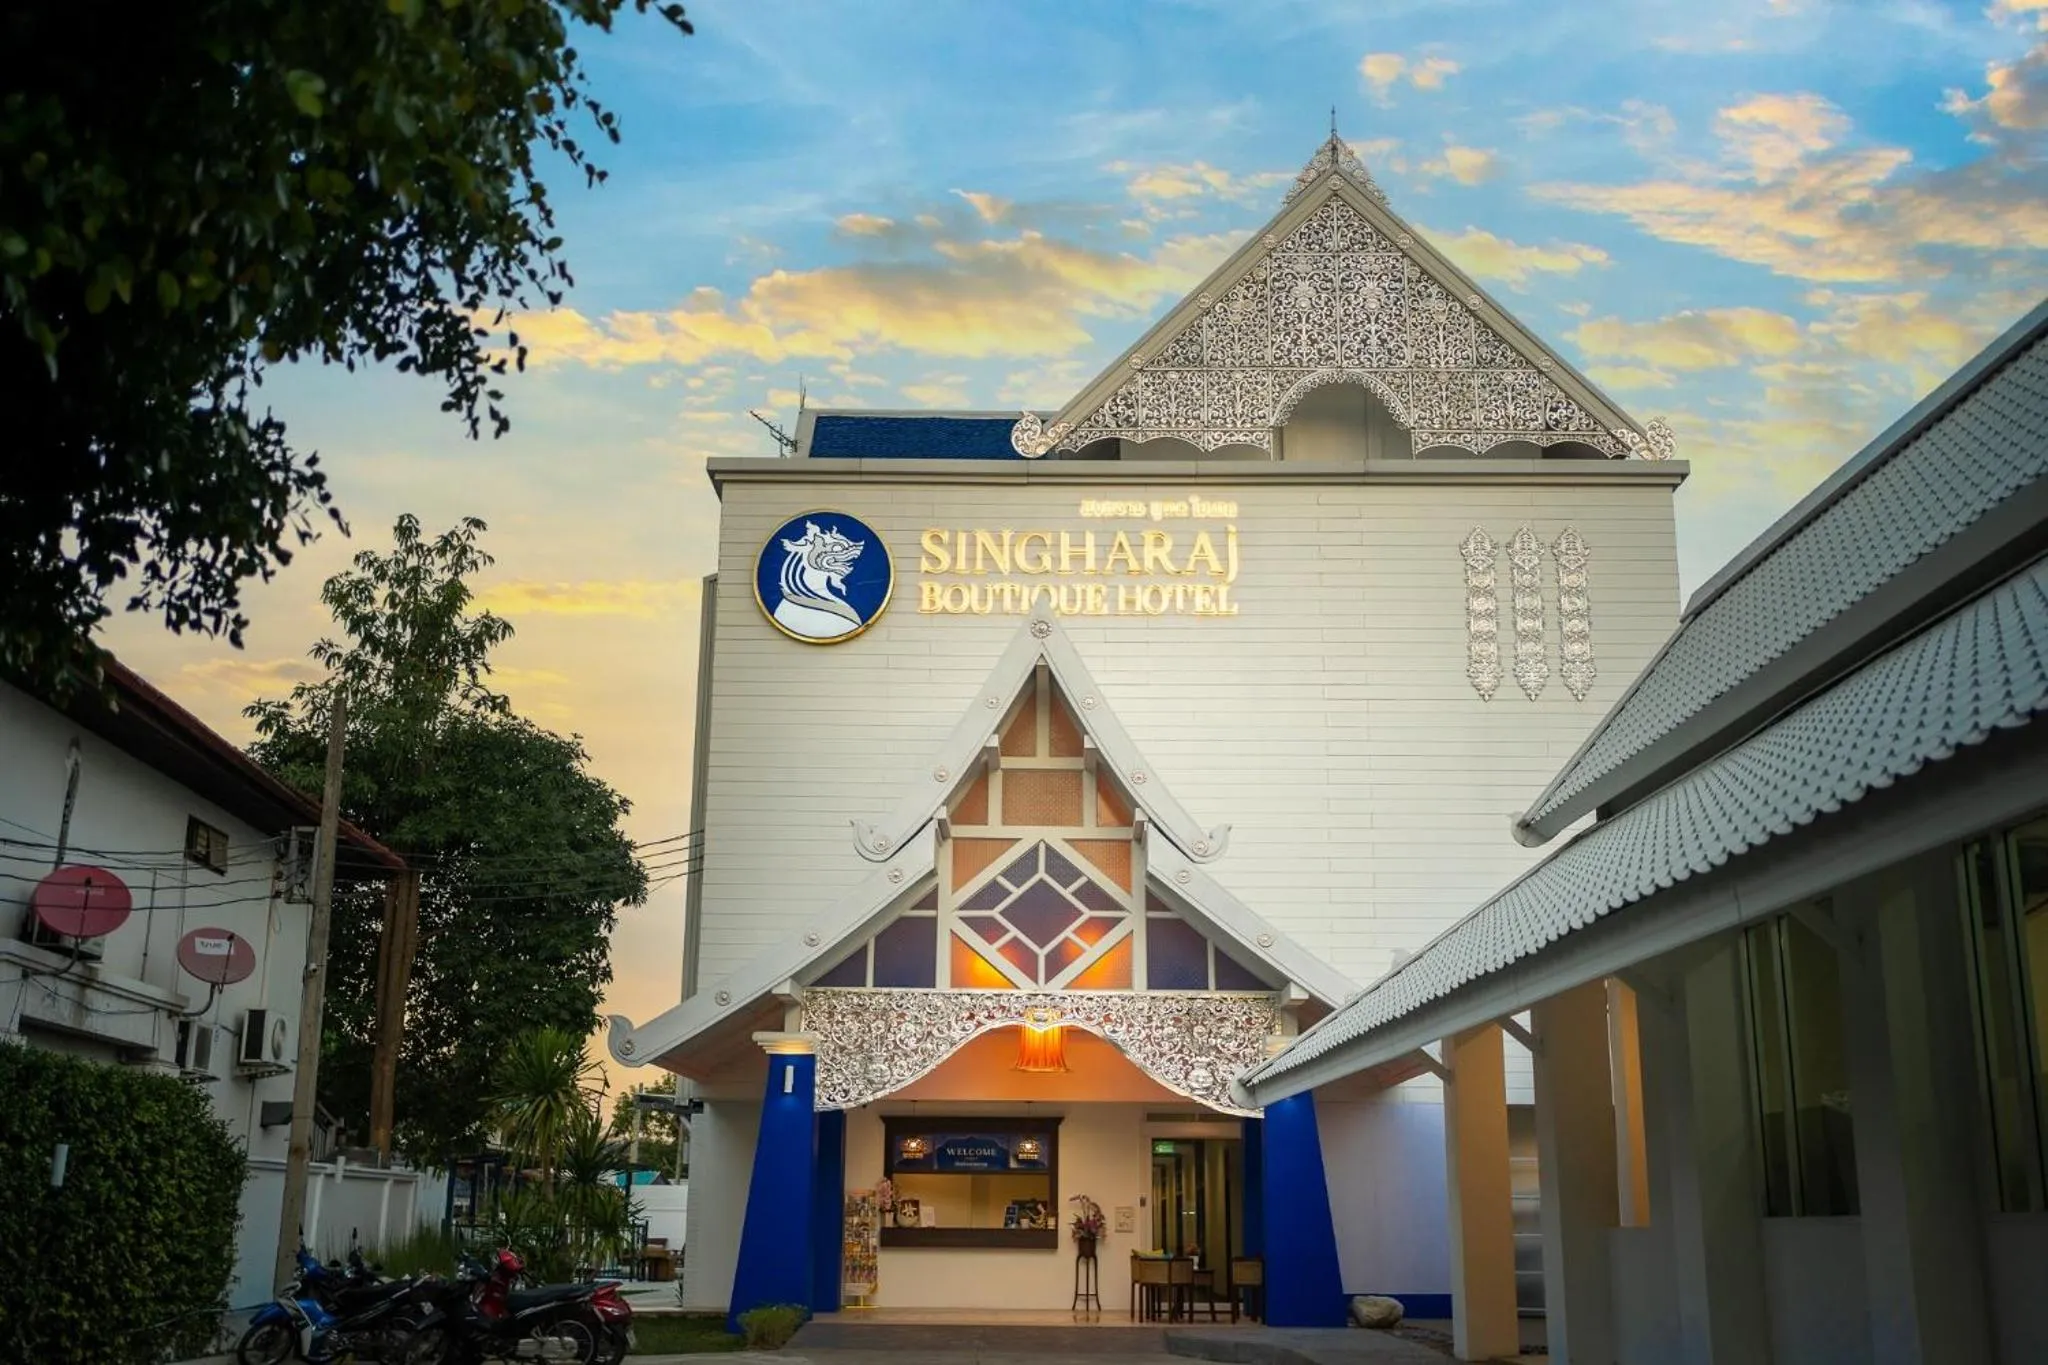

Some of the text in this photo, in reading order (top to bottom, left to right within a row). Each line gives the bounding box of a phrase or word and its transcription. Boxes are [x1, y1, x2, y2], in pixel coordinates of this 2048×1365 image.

[918, 580, 1240, 616] BOUTIQUE HOTEL
[946, 1147, 997, 1156] WELCOME
